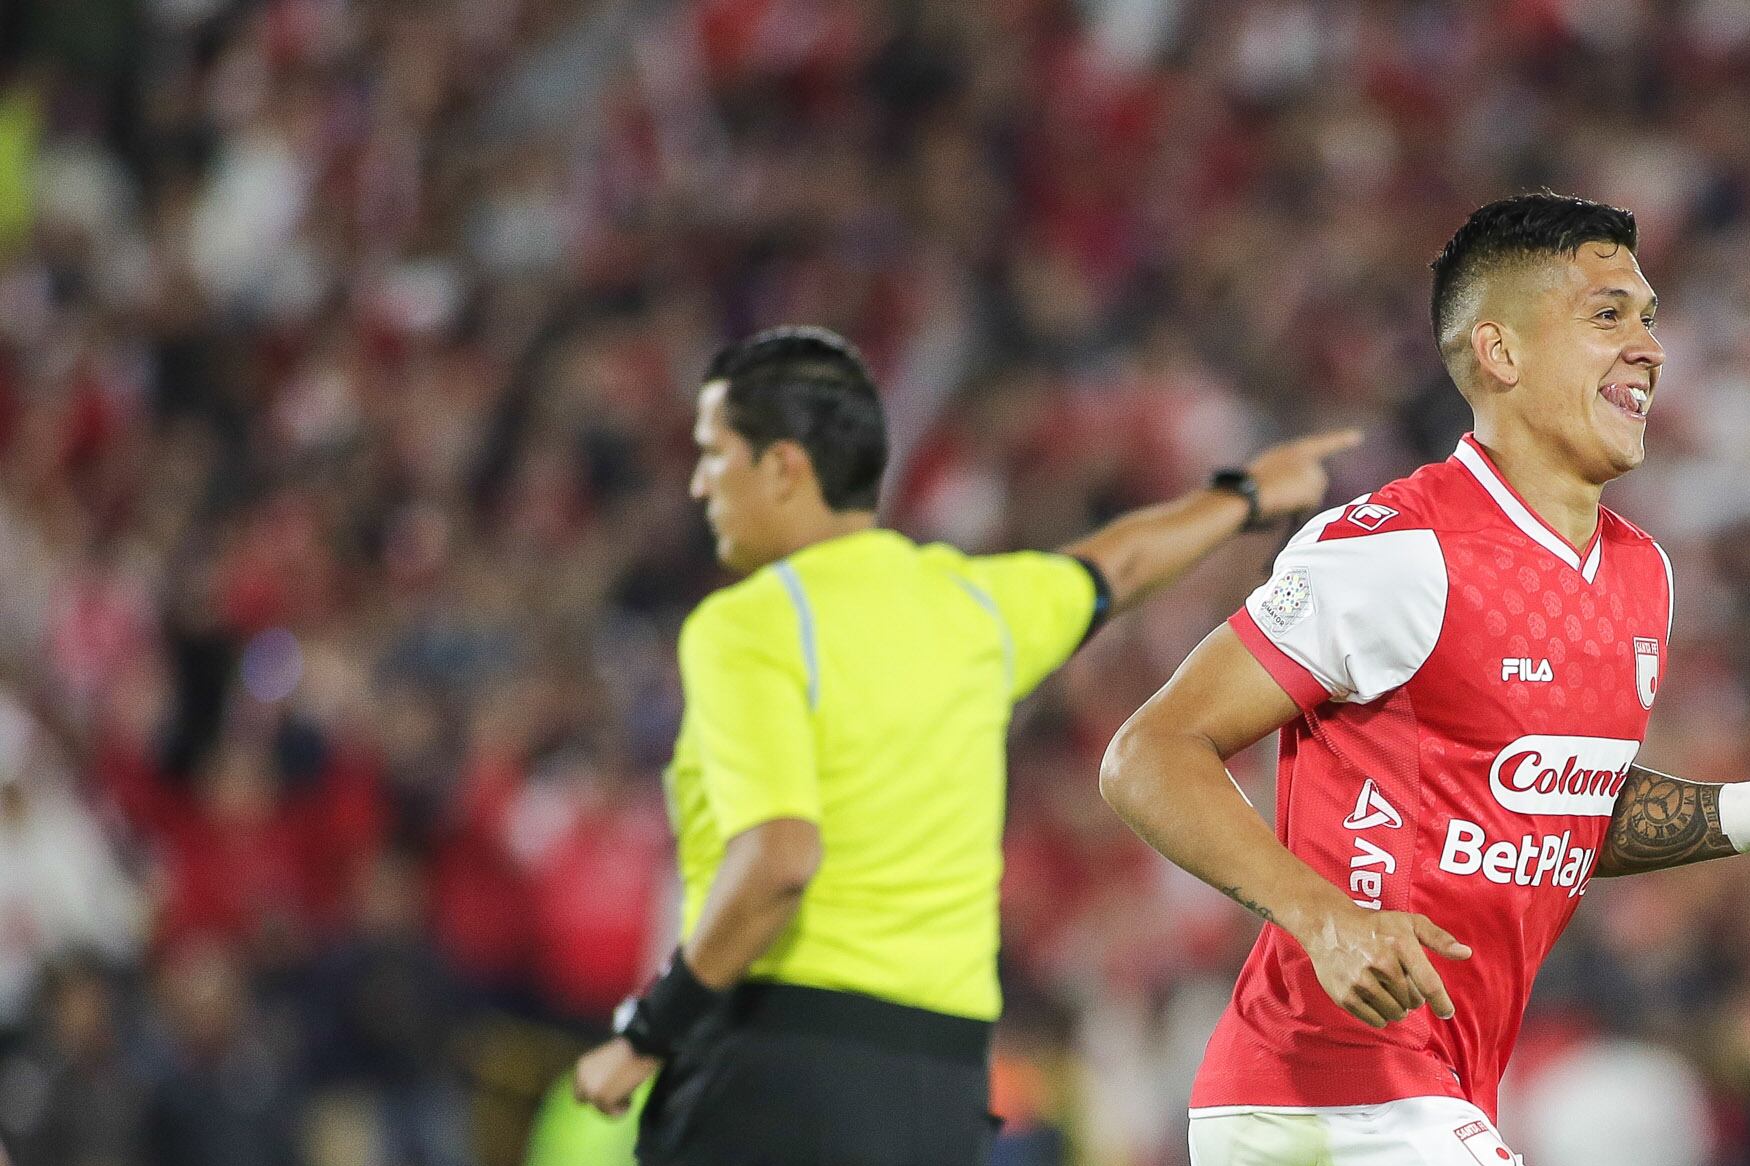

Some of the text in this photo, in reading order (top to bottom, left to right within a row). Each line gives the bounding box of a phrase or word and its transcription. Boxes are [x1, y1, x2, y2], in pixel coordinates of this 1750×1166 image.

[1261, 601, 1285, 626] DIMAYOR
[1502, 658, 1554, 682] FILA
[1438, 818, 1597, 899] BetPlay
